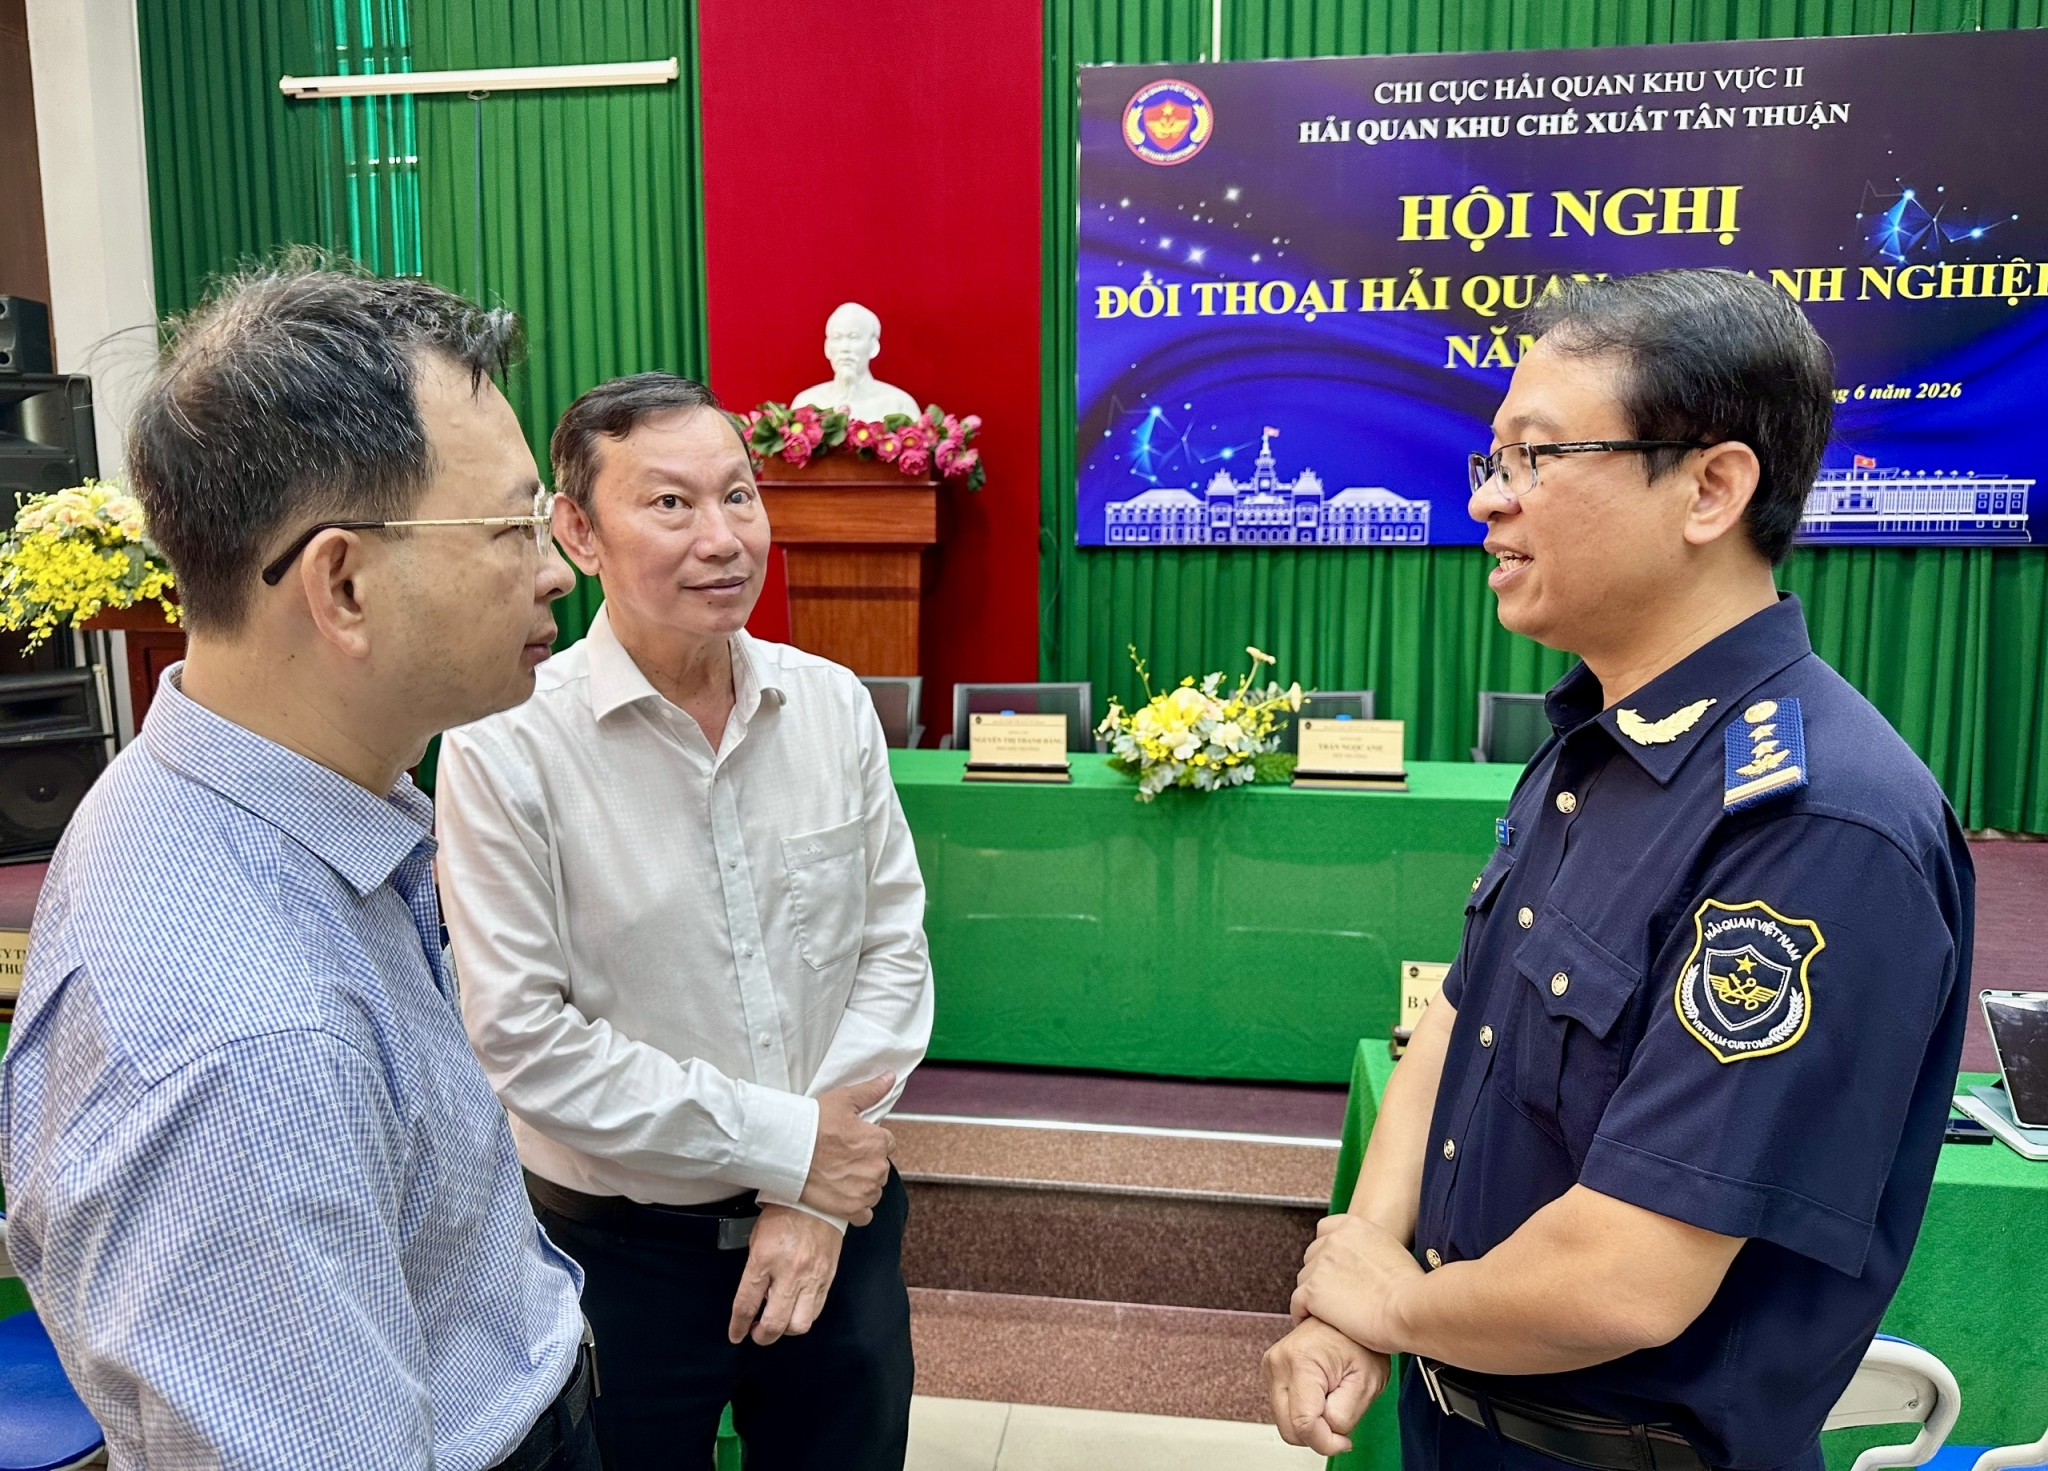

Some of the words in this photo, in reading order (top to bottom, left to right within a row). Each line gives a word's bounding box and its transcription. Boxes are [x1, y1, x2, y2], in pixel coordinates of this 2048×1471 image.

[1374, 82, 1423, 104] CHI
[1429, 79, 1488, 106] CỤC
[1494, 73, 1546, 100] HẢI
[1551, 74, 1636, 102] QUAN
[1642, 71, 1706, 93] KHU
[1713, 66, 1777, 93] VỰC
[1784, 67, 1804, 88] II
[1299, 115, 1351, 143] HẢI
[1357, 118, 1441, 145] QUAN
[1446, 116, 1511, 139] KHU
[1516, 108, 1579, 136] CHẾ
[1584, 105, 1668, 134] XUẤT
[1674, 102, 1736, 131] TÂN
[1742, 101, 1850, 130] THUẬN
[1397, 185, 1534, 252] HỘI
[1549, 185, 1743, 246] NGHỊ
[1191, 278, 1349, 322] THOẠI
[1359, 267, 1452, 313] HẢI
[1461, 270, 1608, 317] QUA
[1854, 384, 1866, 400] 6
[1869, 383, 1911, 400] năm
[1915, 382, 1962, 398] 2026
[1704, 922, 1722, 941] HẢI
[1721, 917, 1756, 931] QUAN
[1757, 919, 1783, 937] VIỆT
[1777, 933, 1802, 961] NAM
[1692, 1018, 1727, 1047] VIETNAM
[1727, 1037, 1773, 1050] CUSTOMS
